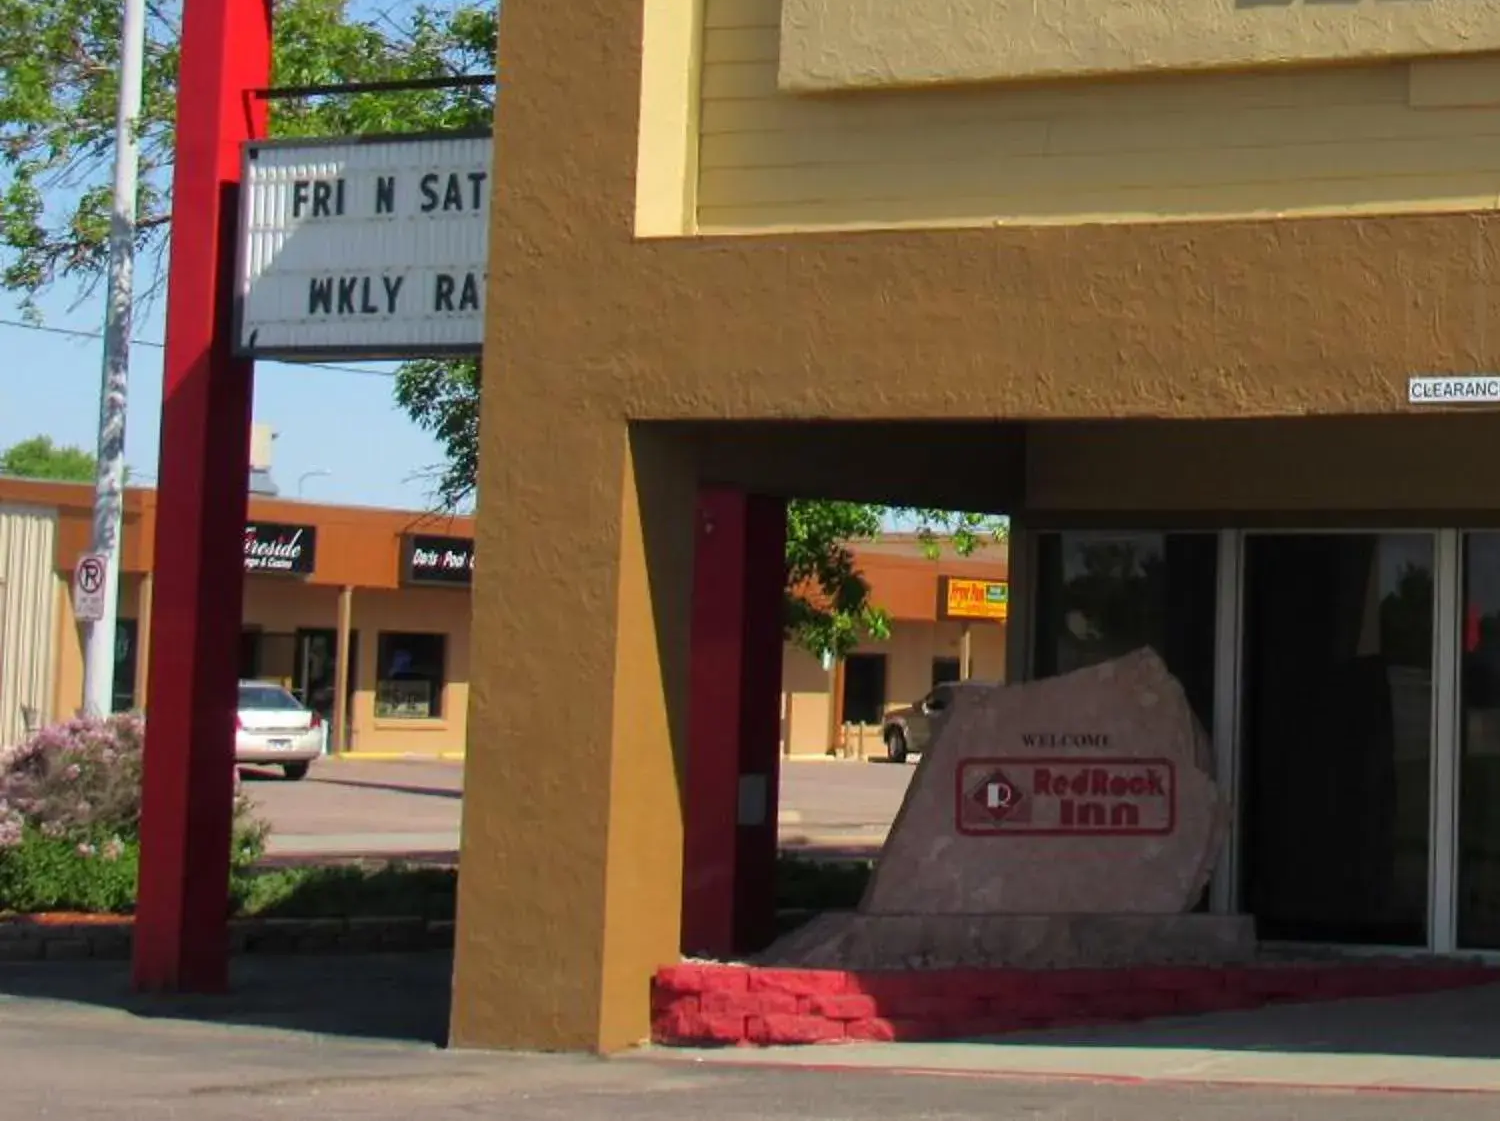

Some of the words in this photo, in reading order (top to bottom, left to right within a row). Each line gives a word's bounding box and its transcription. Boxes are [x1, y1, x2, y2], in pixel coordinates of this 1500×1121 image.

[293, 178, 345, 217] FRI
[376, 177, 395, 214] N
[420, 172, 488, 213] SAT
[308, 275, 404, 315] WKLY
[434, 272, 488, 312] RA
[1021, 733, 1111, 748] WELCOME
[1032, 767, 1165, 797] RedRock
[1060, 799, 1140, 826] Inn
